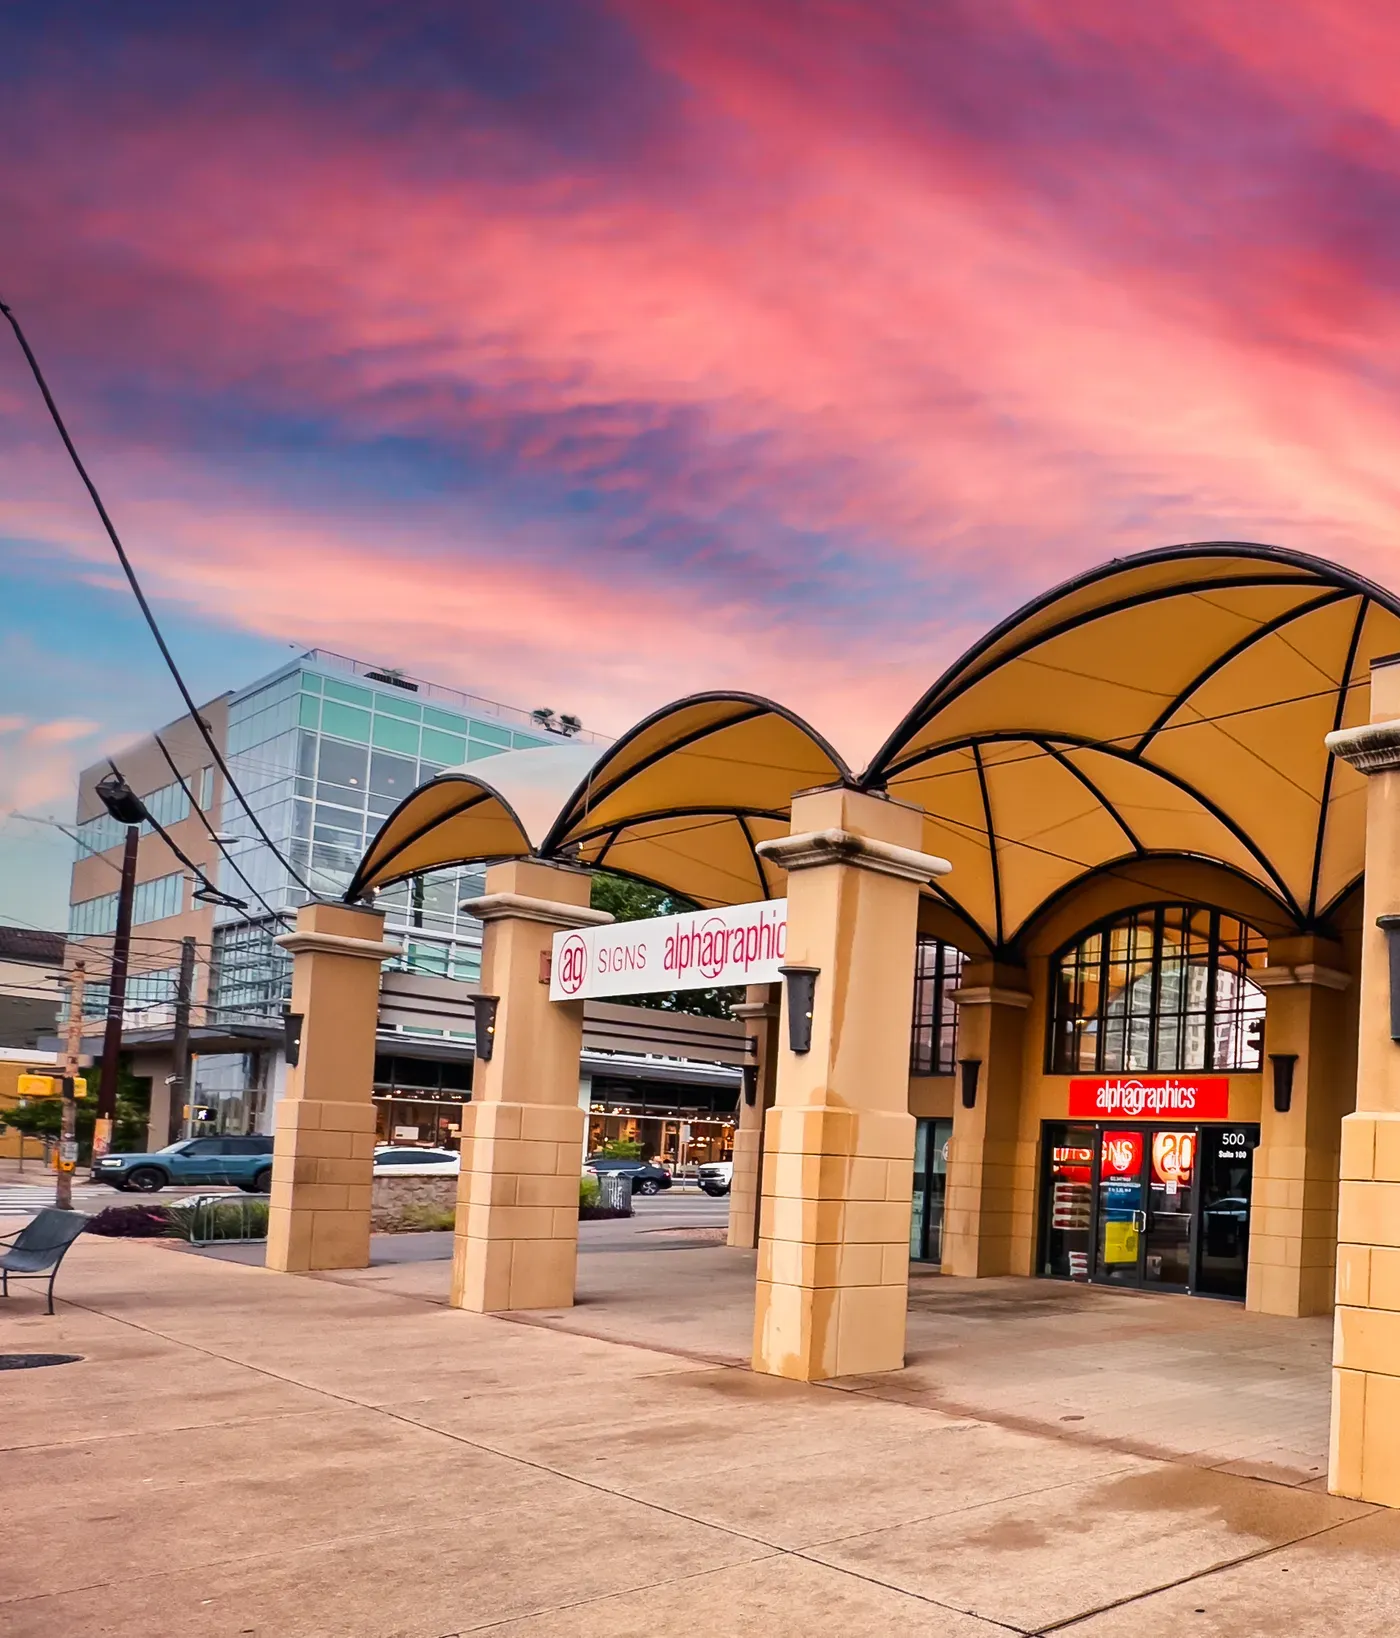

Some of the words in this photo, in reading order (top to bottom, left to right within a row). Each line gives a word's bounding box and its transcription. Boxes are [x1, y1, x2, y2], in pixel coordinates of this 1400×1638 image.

[560, 940, 585, 993] ag
[597, 943, 647, 973] SIGNS
[1096, 1079, 1196, 1115] alphagraphics
[1221, 1133, 1246, 1146] 500
[1235, 1150, 1248, 1159] 100
